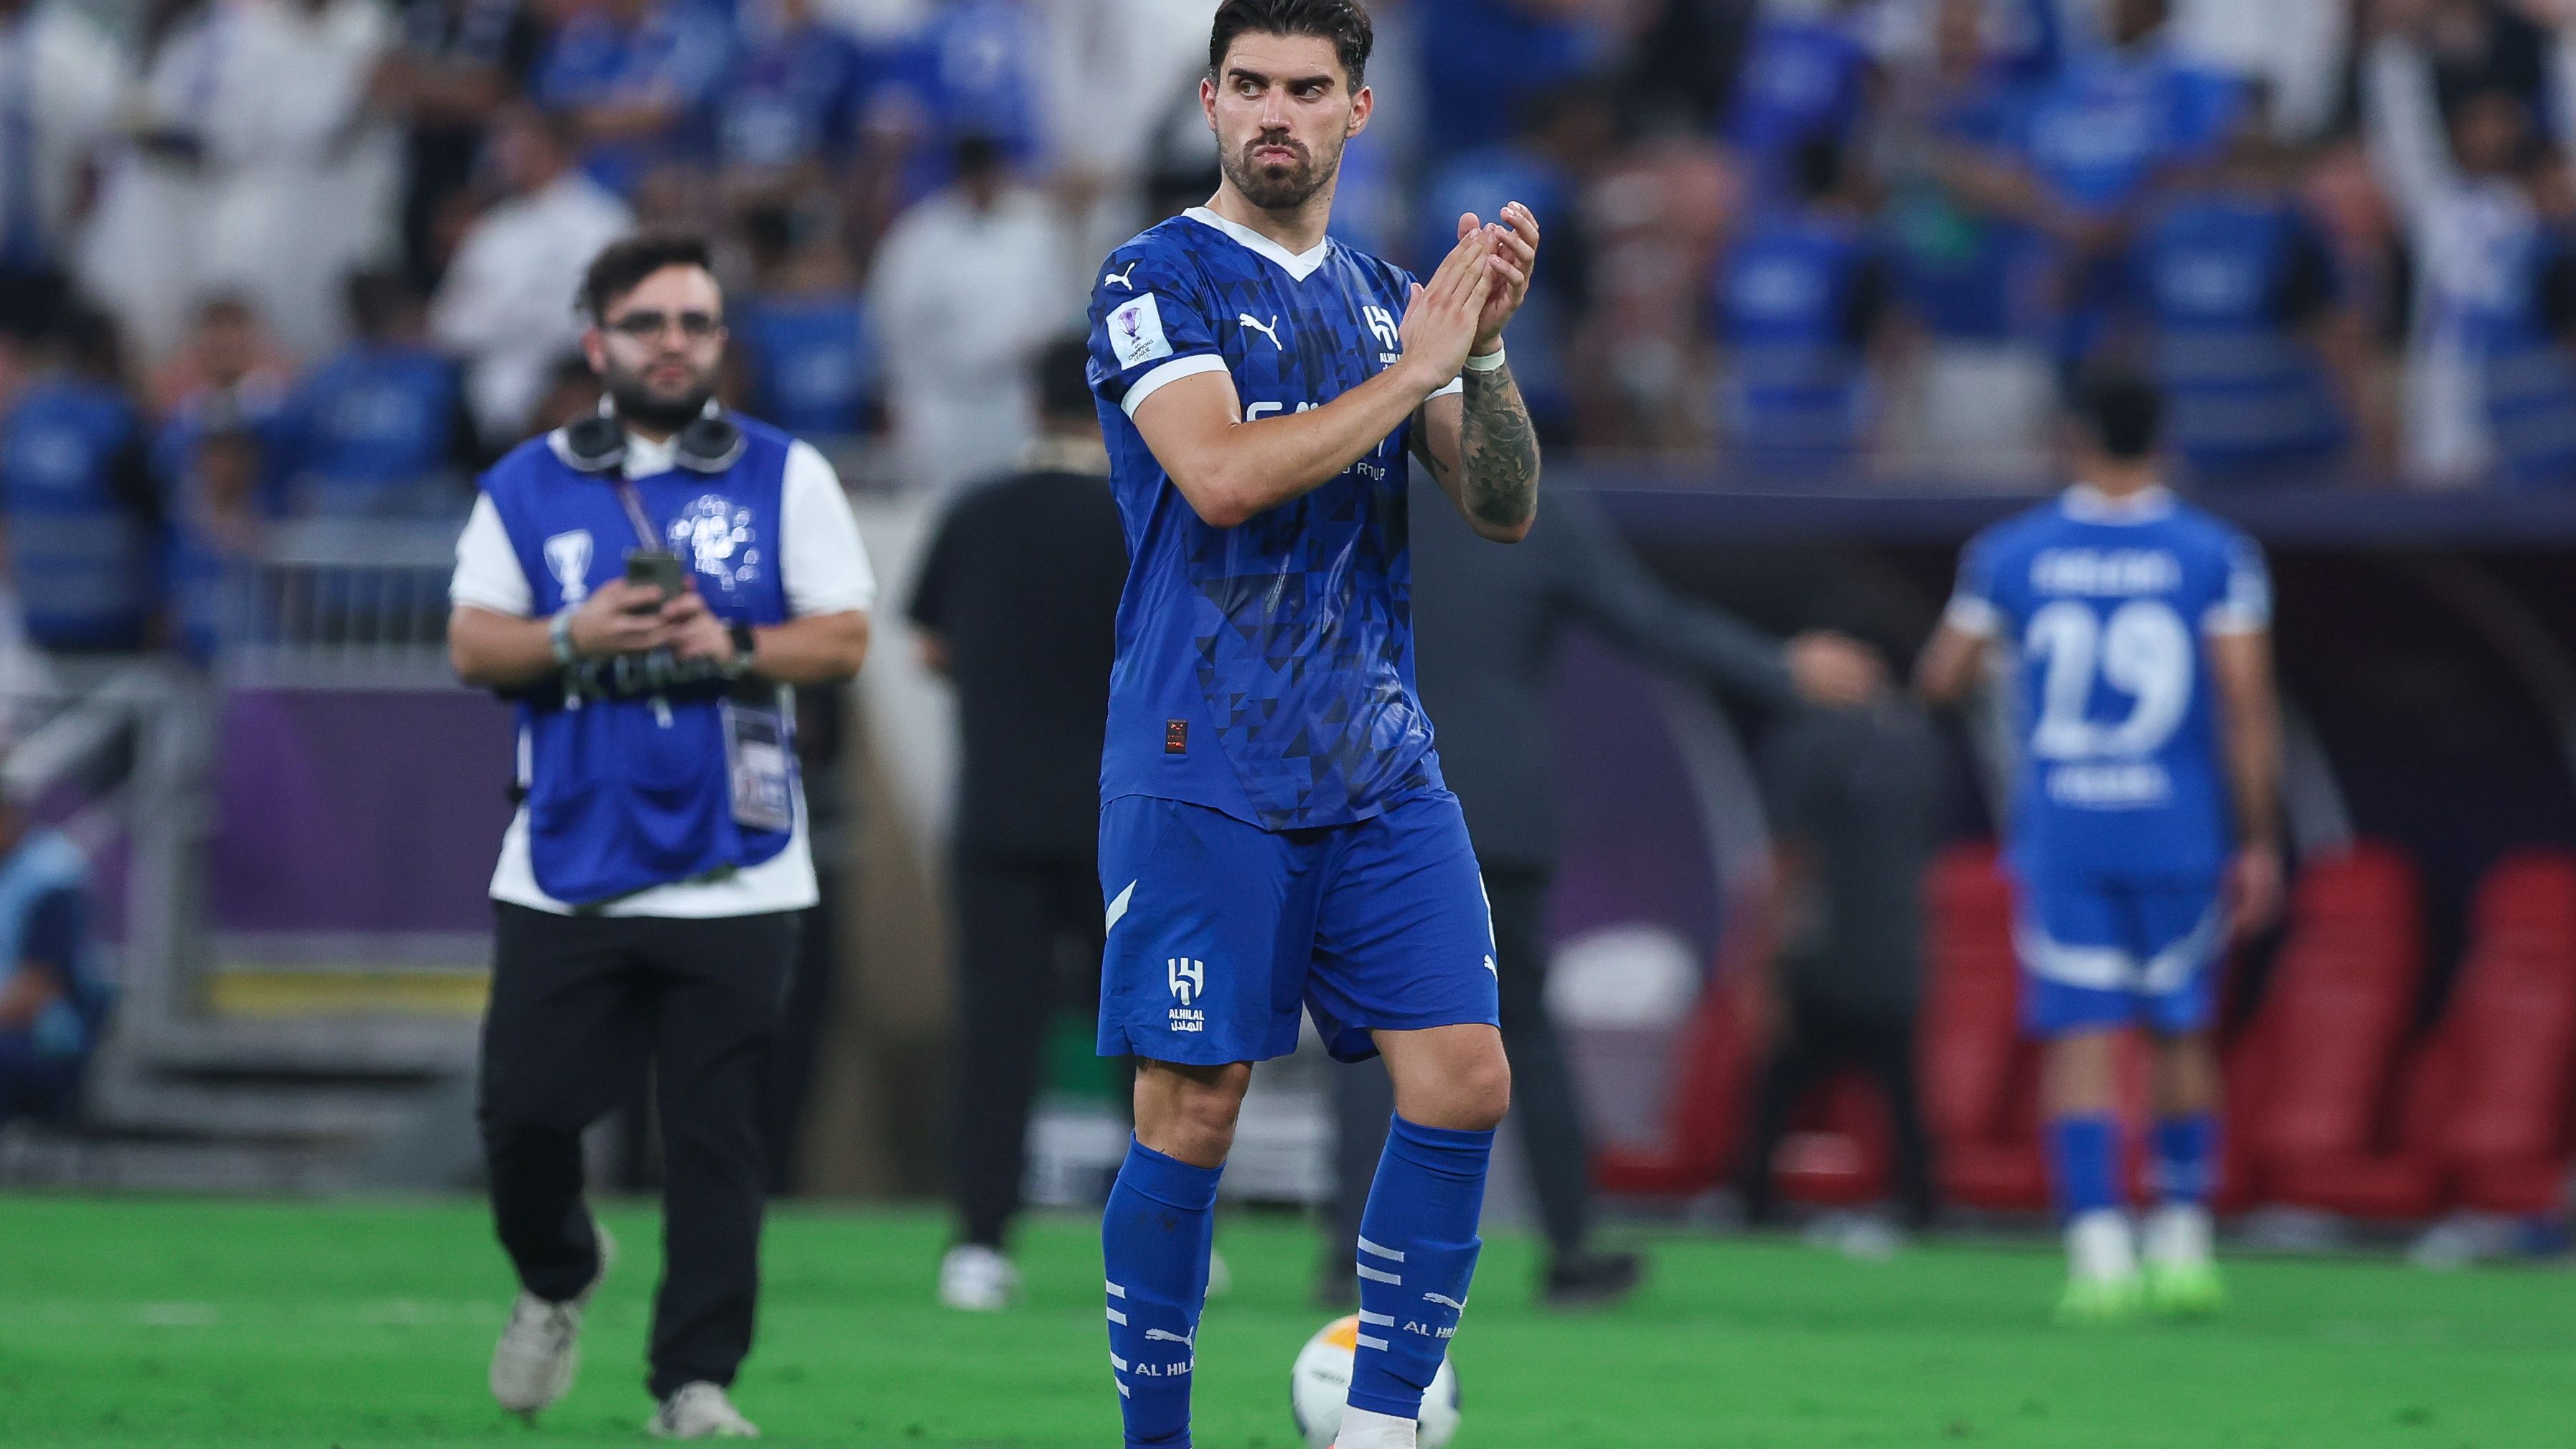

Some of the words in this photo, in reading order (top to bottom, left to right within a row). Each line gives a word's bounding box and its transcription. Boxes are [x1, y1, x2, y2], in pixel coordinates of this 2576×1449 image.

[1128, 339, 1154, 360] CHAMPIONS
[1168, 1008, 1204, 1021] ALHILAL
[1170, 1020, 1203, 1032] الهلال
[1402, 1321, 1430, 1336] AL
[1135, 1363, 1162, 1376] AL
